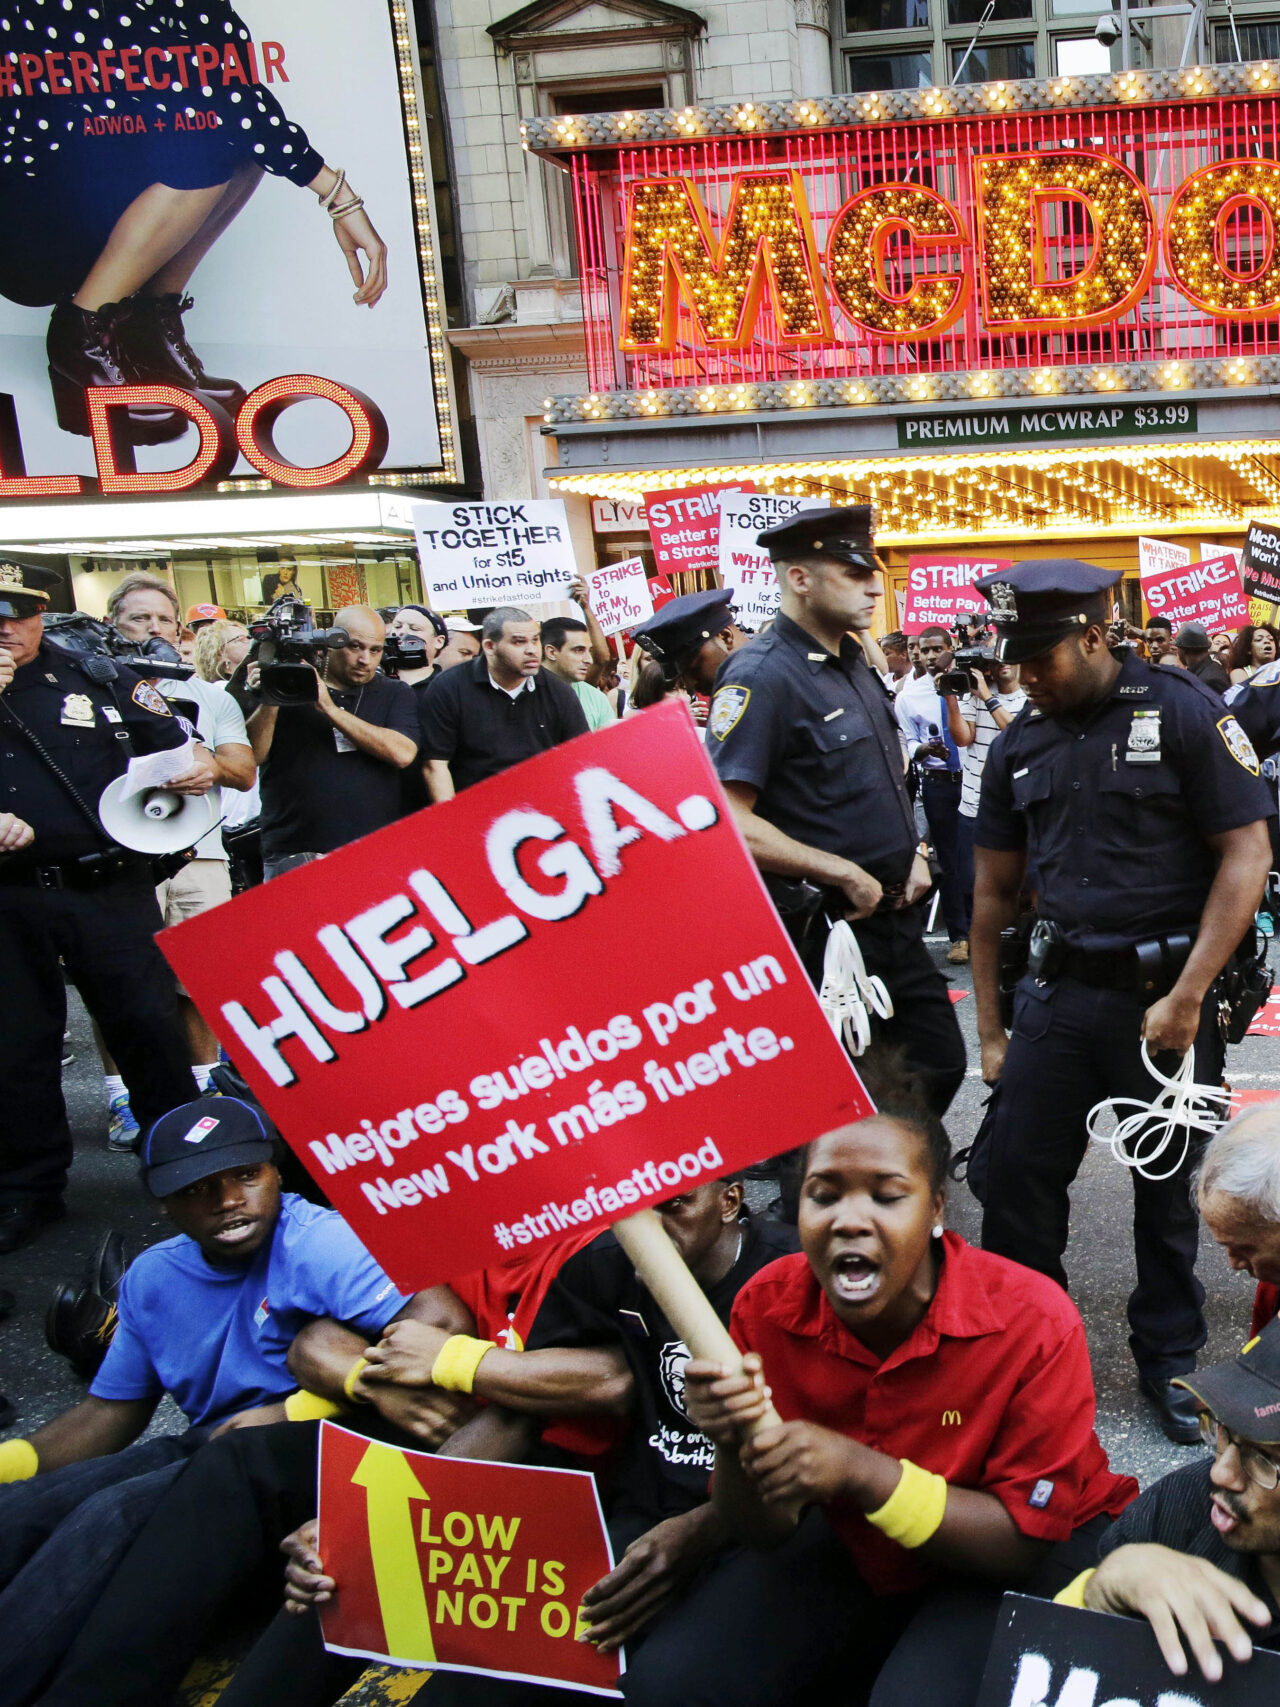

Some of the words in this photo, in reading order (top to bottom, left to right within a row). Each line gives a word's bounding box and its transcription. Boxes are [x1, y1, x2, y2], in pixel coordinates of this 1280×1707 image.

[0, 41, 290, 98] #PERFECTPAIR
[83, 115, 147, 137] ADWOA
[174, 110, 219, 132] ALDO
[906, 416, 1009, 440] PREMIUM
[1020, 409, 1124, 433] MCWRAP
[1134, 405, 1190, 428] $3.99
[452, 505, 528, 527] STICK
[649, 487, 742, 528] STRIK
[749, 498, 801, 514] STICK
[423, 526, 562, 549] TOGETHER
[660, 529, 706, 545] Better
[473, 556, 492, 569] for
[659, 550, 669, 560] a
[671, 545, 719, 558] Strong
[1142, 542, 1188, 563] WHATEVER
[1251, 546, 1278, 566] Won't
[433, 580, 457, 592] and
[462, 574, 512, 588] Union
[517, 569, 572, 587] Rights
[592, 562, 643, 589] STRIKE
[741, 569, 756, 585] IT
[1242, 565, 1258, 581] We
[599, 590, 610, 599] to
[1148, 561, 1235, 608] STRIKE.
[472, 591, 541, 604] #strikefastfood
[594, 601, 608, 617] ift
[610, 596, 628, 609] My
[758, 592, 771, 601] for
[914, 596, 954, 608] Better
[956, 598, 980, 612] Pay
[1199, 597, 1221, 611] Pay
[1223, 592, 1239, 605] for
[623, 605, 642, 617] Up
[907, 614, 916, 622] a
[1170, 611, 1219, 635] Stnger
[1222, 604, 1247, 621] NYC
[220, 767, 719, 1088] HUELGA.
[309, 1085, 469, 1176] Mejores
[469, 1013, 642, 1111] sueldos
[642, 975, 714, 1046] por
[722, 952, 788, 1004] un
[359, 1163, 453, 1216] New
[443, 1120, 554, 1182] York
[551, 1079, 647, 1147] más
[639, 1027, 795, 1105] fuerte.
[493, 1136, 724, 1251] #strikefastfood
[420, 1507, 521, 1551] LOW
[428, 1549, 511, 1590] PAY
[525, 1558, 566, 1596] IS
[435, 1590, 526, 1632] NOT
